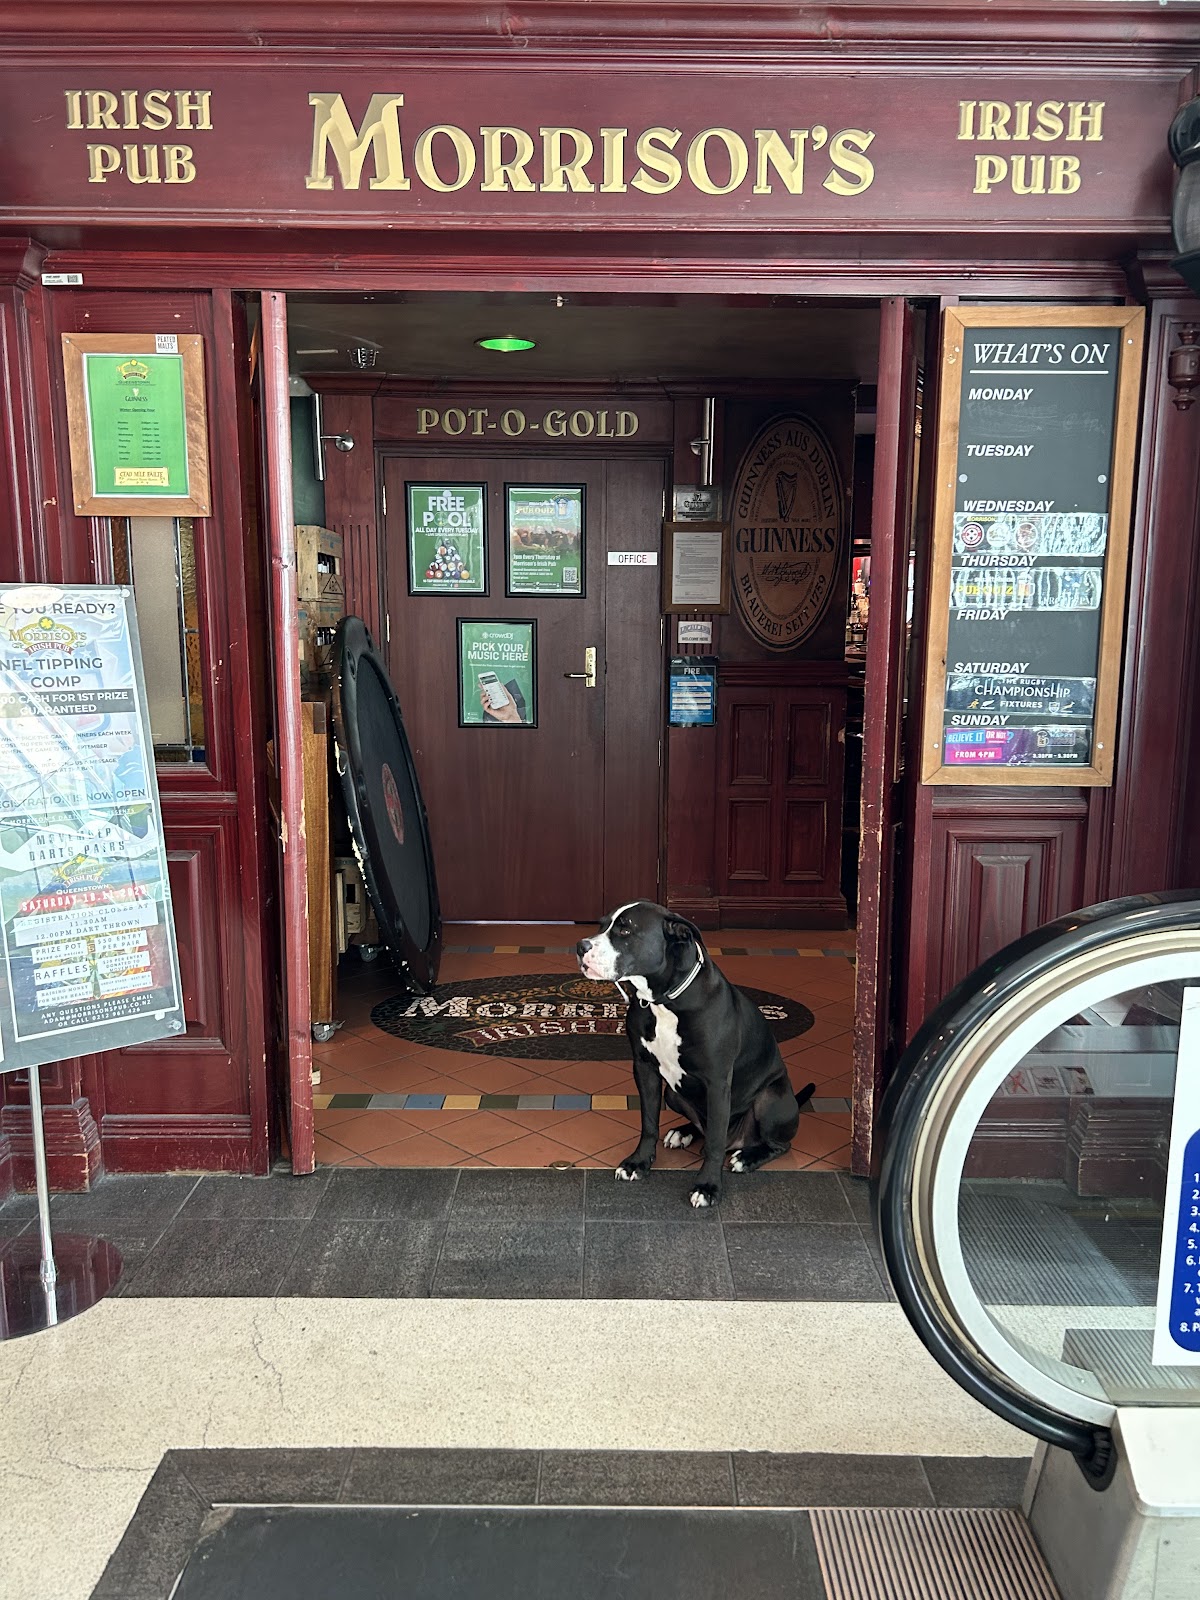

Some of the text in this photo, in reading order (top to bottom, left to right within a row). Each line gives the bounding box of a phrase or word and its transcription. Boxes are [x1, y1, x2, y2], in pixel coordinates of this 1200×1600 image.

[65, 90, 213, 130] IRISH
[957, 100, 1105, 141] IRISH
[305, 93, 876, 196] MORRISON'S
[87, 144, 197, 185] PUB
[973, 154, 1082, 194] PUB
[974, 343, 1110, 364] WHAT'S ON
[969, 388, 1033, 400] MONDAY
[416, 408, 639, 437] POT-O-GOLD
[966, 445, 1034, 456] TUESDAY
[738, 433, 782, 520] GUINNESS
[786, 429, 810, 452] AUS
[808, 446, 836, 520] DUBLIN
[428, 496, 465, 511] FREE
[963, 500, 1054, 512] WEDNESDAY
[735, 528, 836, 553] GUINNESS
[618, 554, 647, 563] OFFICE
[960, 555, 1038, 566] THURSDAY
[53, 603, 116, 614] READY?
[740, 573, 782, 637] BRAUEREI
[810, 574, 827, 614] 1759
[957, 610, 1009, 620] FRIDAY
[9, 629, 87, 641] MORRISON'S
[28, 643, 70, 653] IRISH PUB
[472, 642, 524, 652] PICK YOUR
[468, 651, 528, 661] MUSIC HERE
[0, 658, 103, 671] NFL TIPPING
[954, 662, 1029, 674] SATURDAY
[31, 675, 81, 688] COMP
[974, 681, 1070, 698] CHAMPIONSHIP
[19, 691, 128, 704] CASH FOR 1ST PRIZE
[20, 704, 97, 716] GUARANTEED
[951, 715, 1009, 726] SUNDAY
[948, 732, 973, 743] BELIEVE
[975, 731, 984, 742] IT
[86, 791, 113, 800] NOW
[115, 789, 146, 799] OPEN
[29, 841, 125, 861] DARTS PAIRS
[56, 884, 109, 895] QUEENSTOWN
[21, 895, 77, 911] SATURDAY
[36, 920, 140, 940] 12.00PM DART THROWN
[36, 942, 81, 955] PRIZE POT
[35, 964, 88, 980] RAFFLES
[60, 1004, 101, 1015] QUESTIONS
[104, 998, 130, 1007] PLEASE
[132, 994, 153, 1002] EMAIL
[44, 1000, 151, 1025] ADAM@MORRISONSPUB.CO.NZ
[71, 1017, 89, 1025] CALL
[477, 1020, 597, 1041] IRISH
